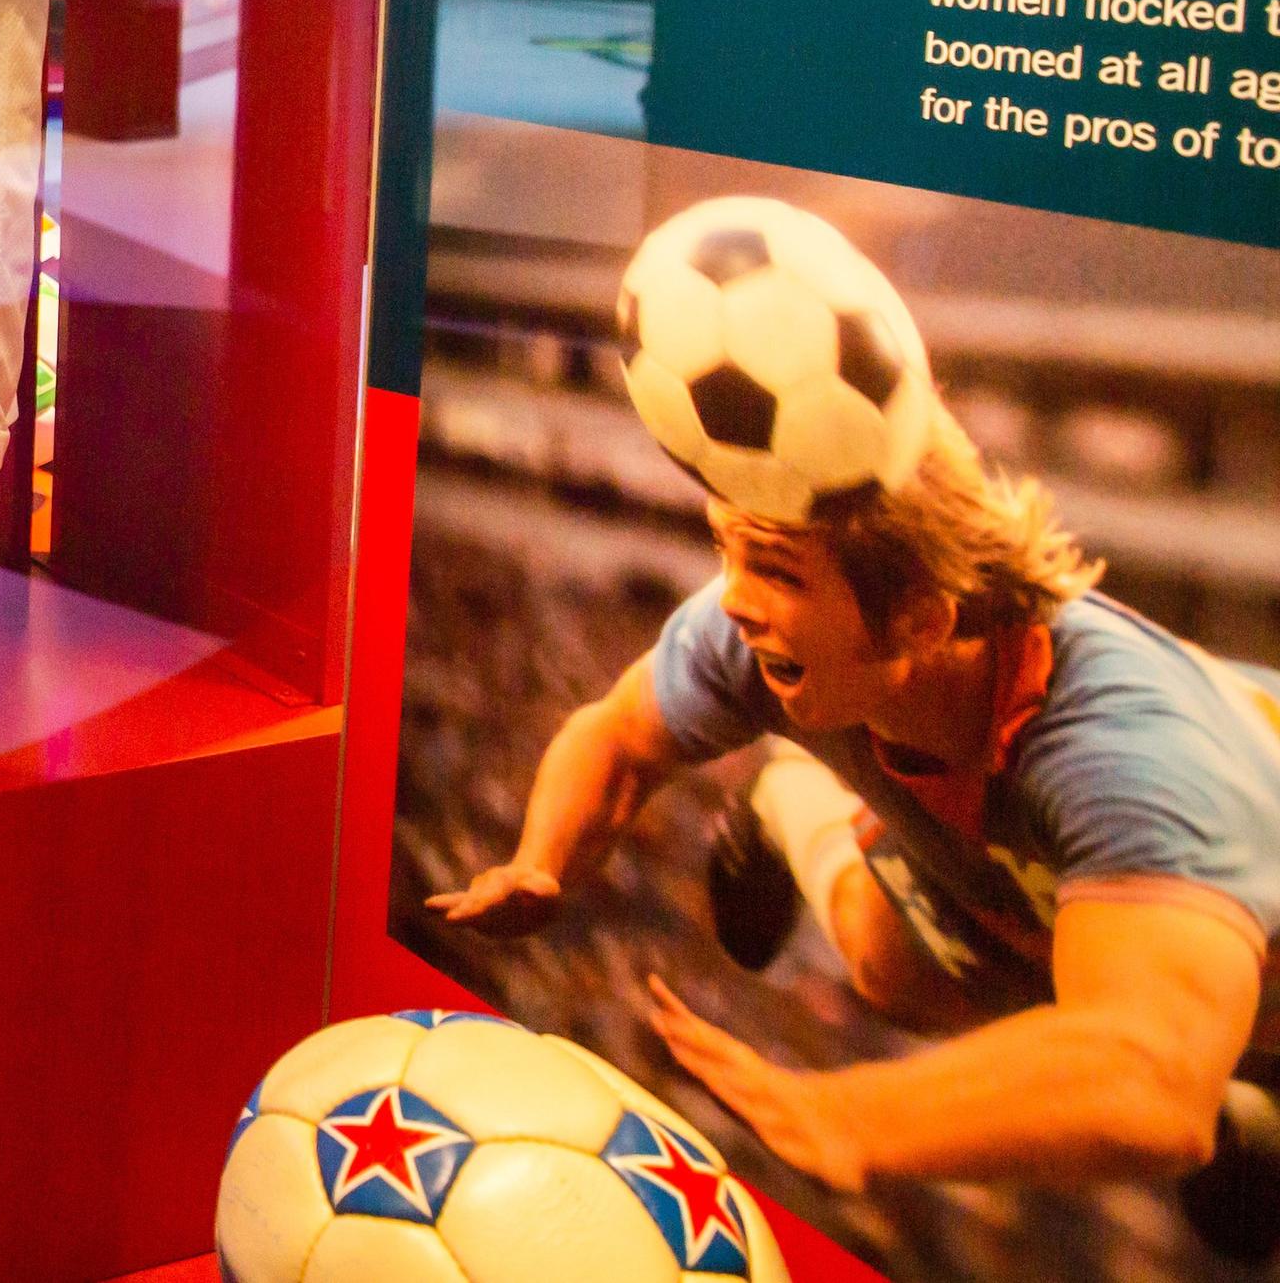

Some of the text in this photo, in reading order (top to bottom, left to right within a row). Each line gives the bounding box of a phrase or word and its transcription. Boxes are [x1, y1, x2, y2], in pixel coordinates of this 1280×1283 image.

[925, 30, 1083, 81] boomed
[1098, 51, 1143, 88] at
[1157, 55, 1211, 95] all
[920, 87, 972, 126] for
[983, 96, 1049, 137] the
[1063, 113, 1158, 153] pros
[1172, 121, 1221, 159] of
